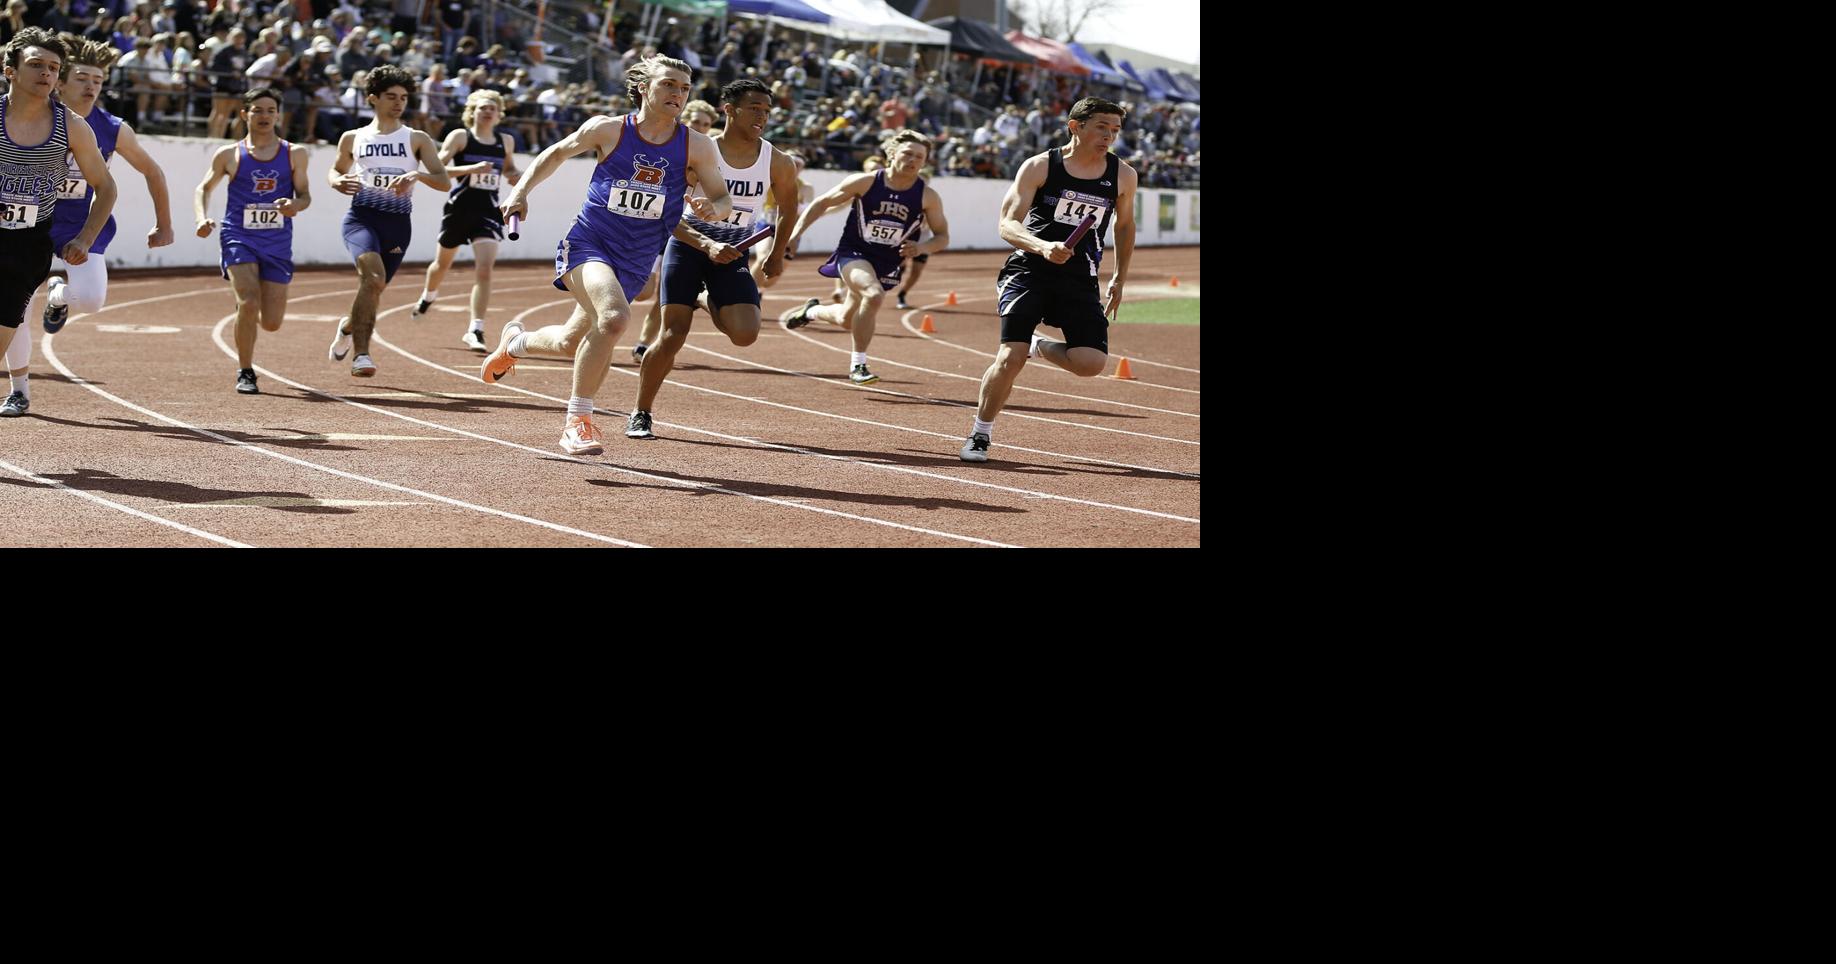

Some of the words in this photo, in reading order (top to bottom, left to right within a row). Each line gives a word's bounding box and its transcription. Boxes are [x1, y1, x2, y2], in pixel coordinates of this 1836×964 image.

[359, 143, 407, 158] LOYOLA
[0, 172, 57, 196] GLES
[373, 175, 398, 188] 61
[476, 174, 496, 186] 146
[725, 179, 764, 196] YOLA
[617, 190, 657, 212] 107
[250, 210, 278, 224] 102
[872, 201, 909, 221] JHS
[871, 225, 898, 240] 557
